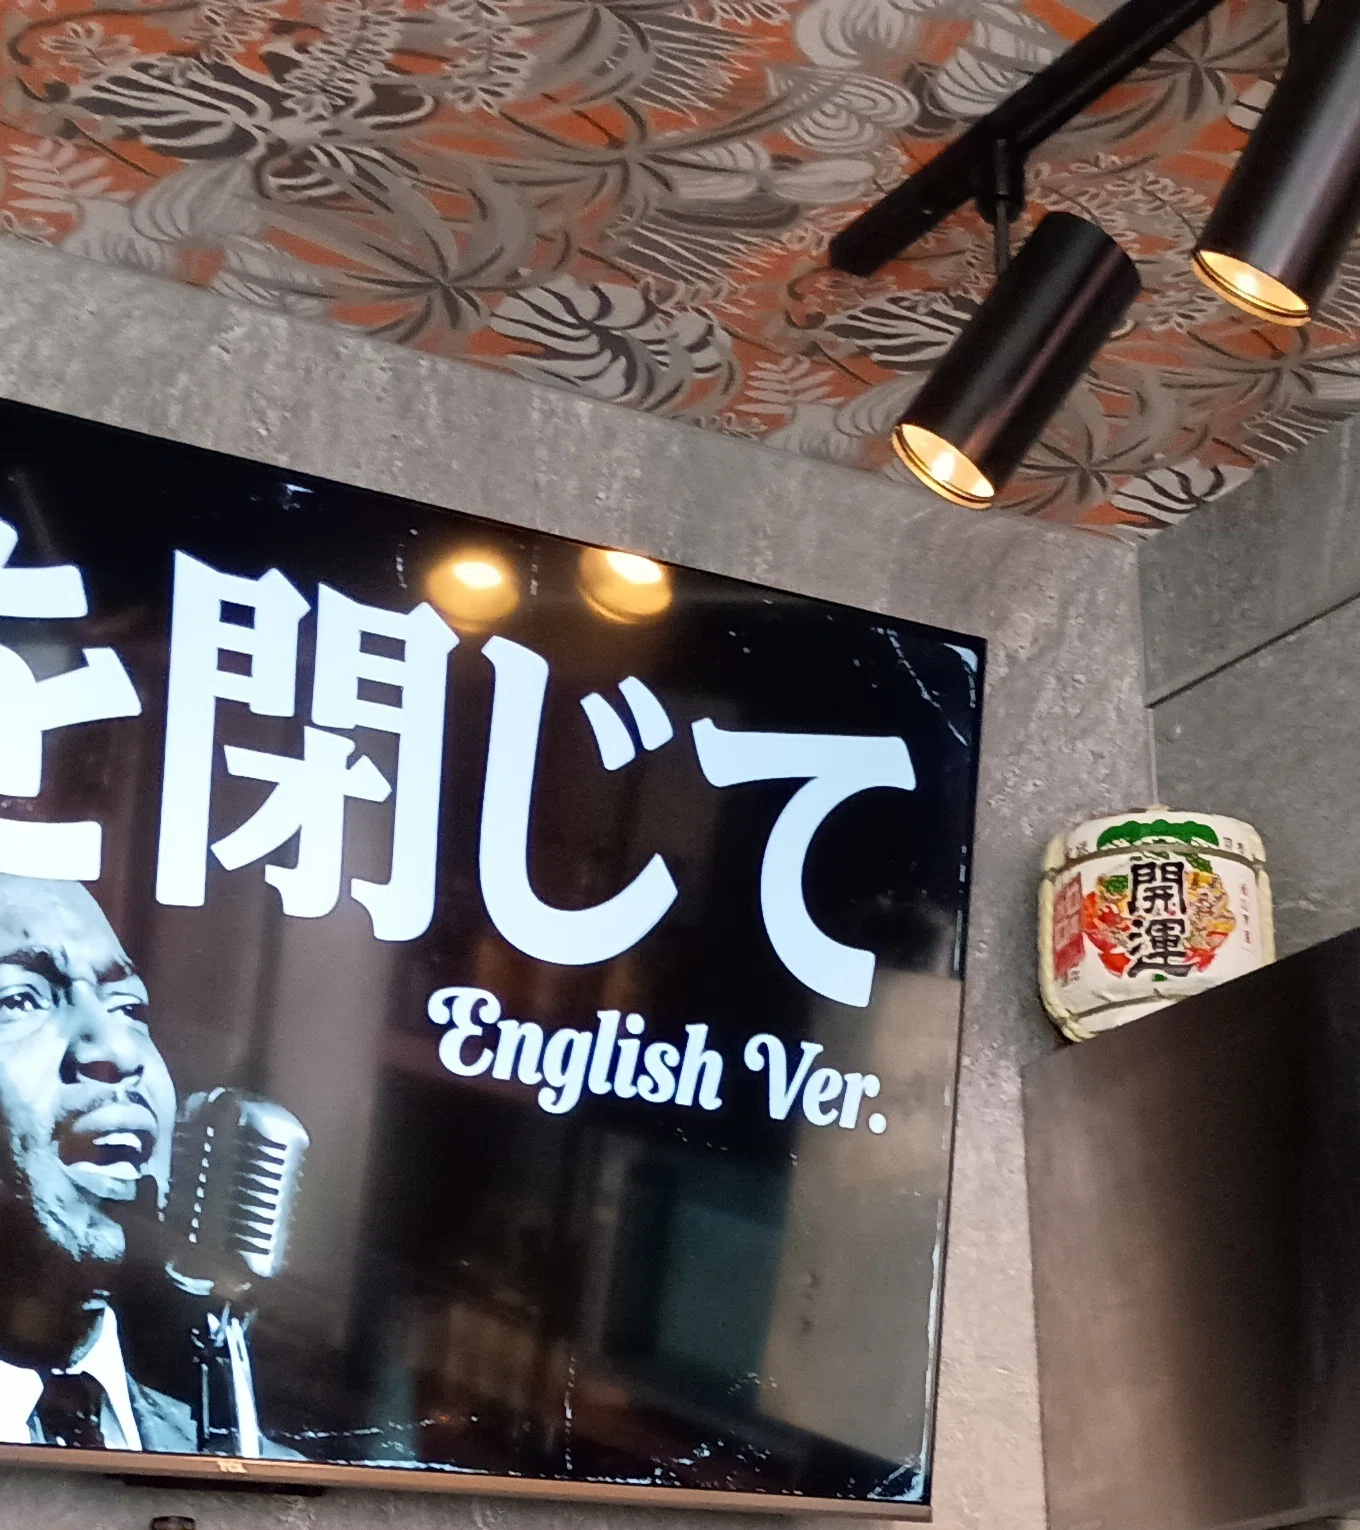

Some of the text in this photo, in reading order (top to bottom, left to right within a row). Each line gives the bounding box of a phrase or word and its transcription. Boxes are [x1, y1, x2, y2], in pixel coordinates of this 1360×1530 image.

[1127, 861, 1195, 978] 開運
[427, 986, 887, 1134] English Ver.
